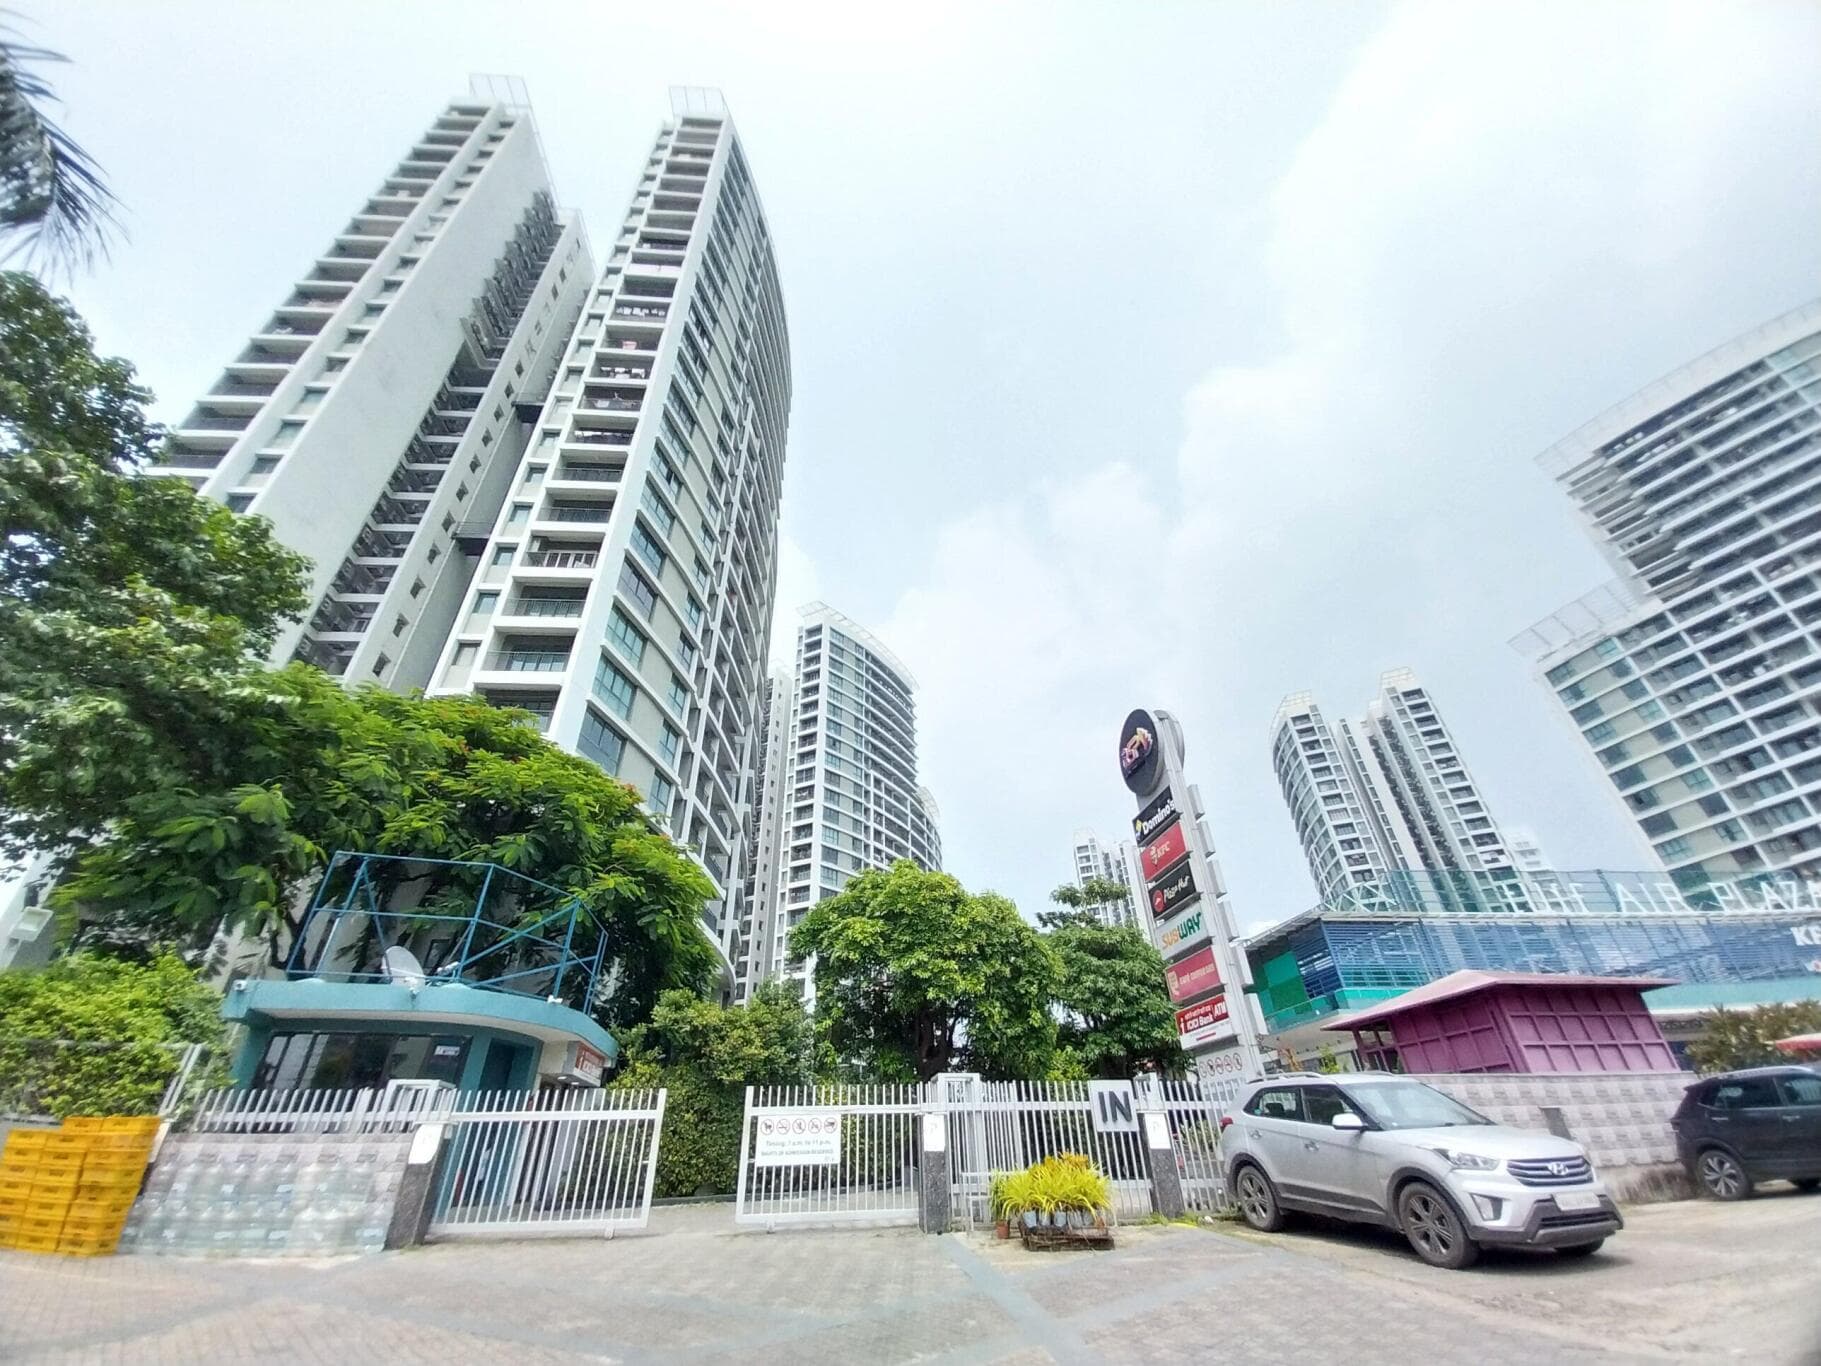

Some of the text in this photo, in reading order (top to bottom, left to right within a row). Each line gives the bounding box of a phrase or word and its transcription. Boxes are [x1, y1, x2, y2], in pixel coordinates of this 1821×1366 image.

[1142, 798, 1175, 836] Domino's
[1156, 840, 1171, 858] KFC
[1615, 882, 1696, 913] AIR
[1162, 911, 1202, 950] SUBWAY
[1098, 1091, 1132, 1123] IN
